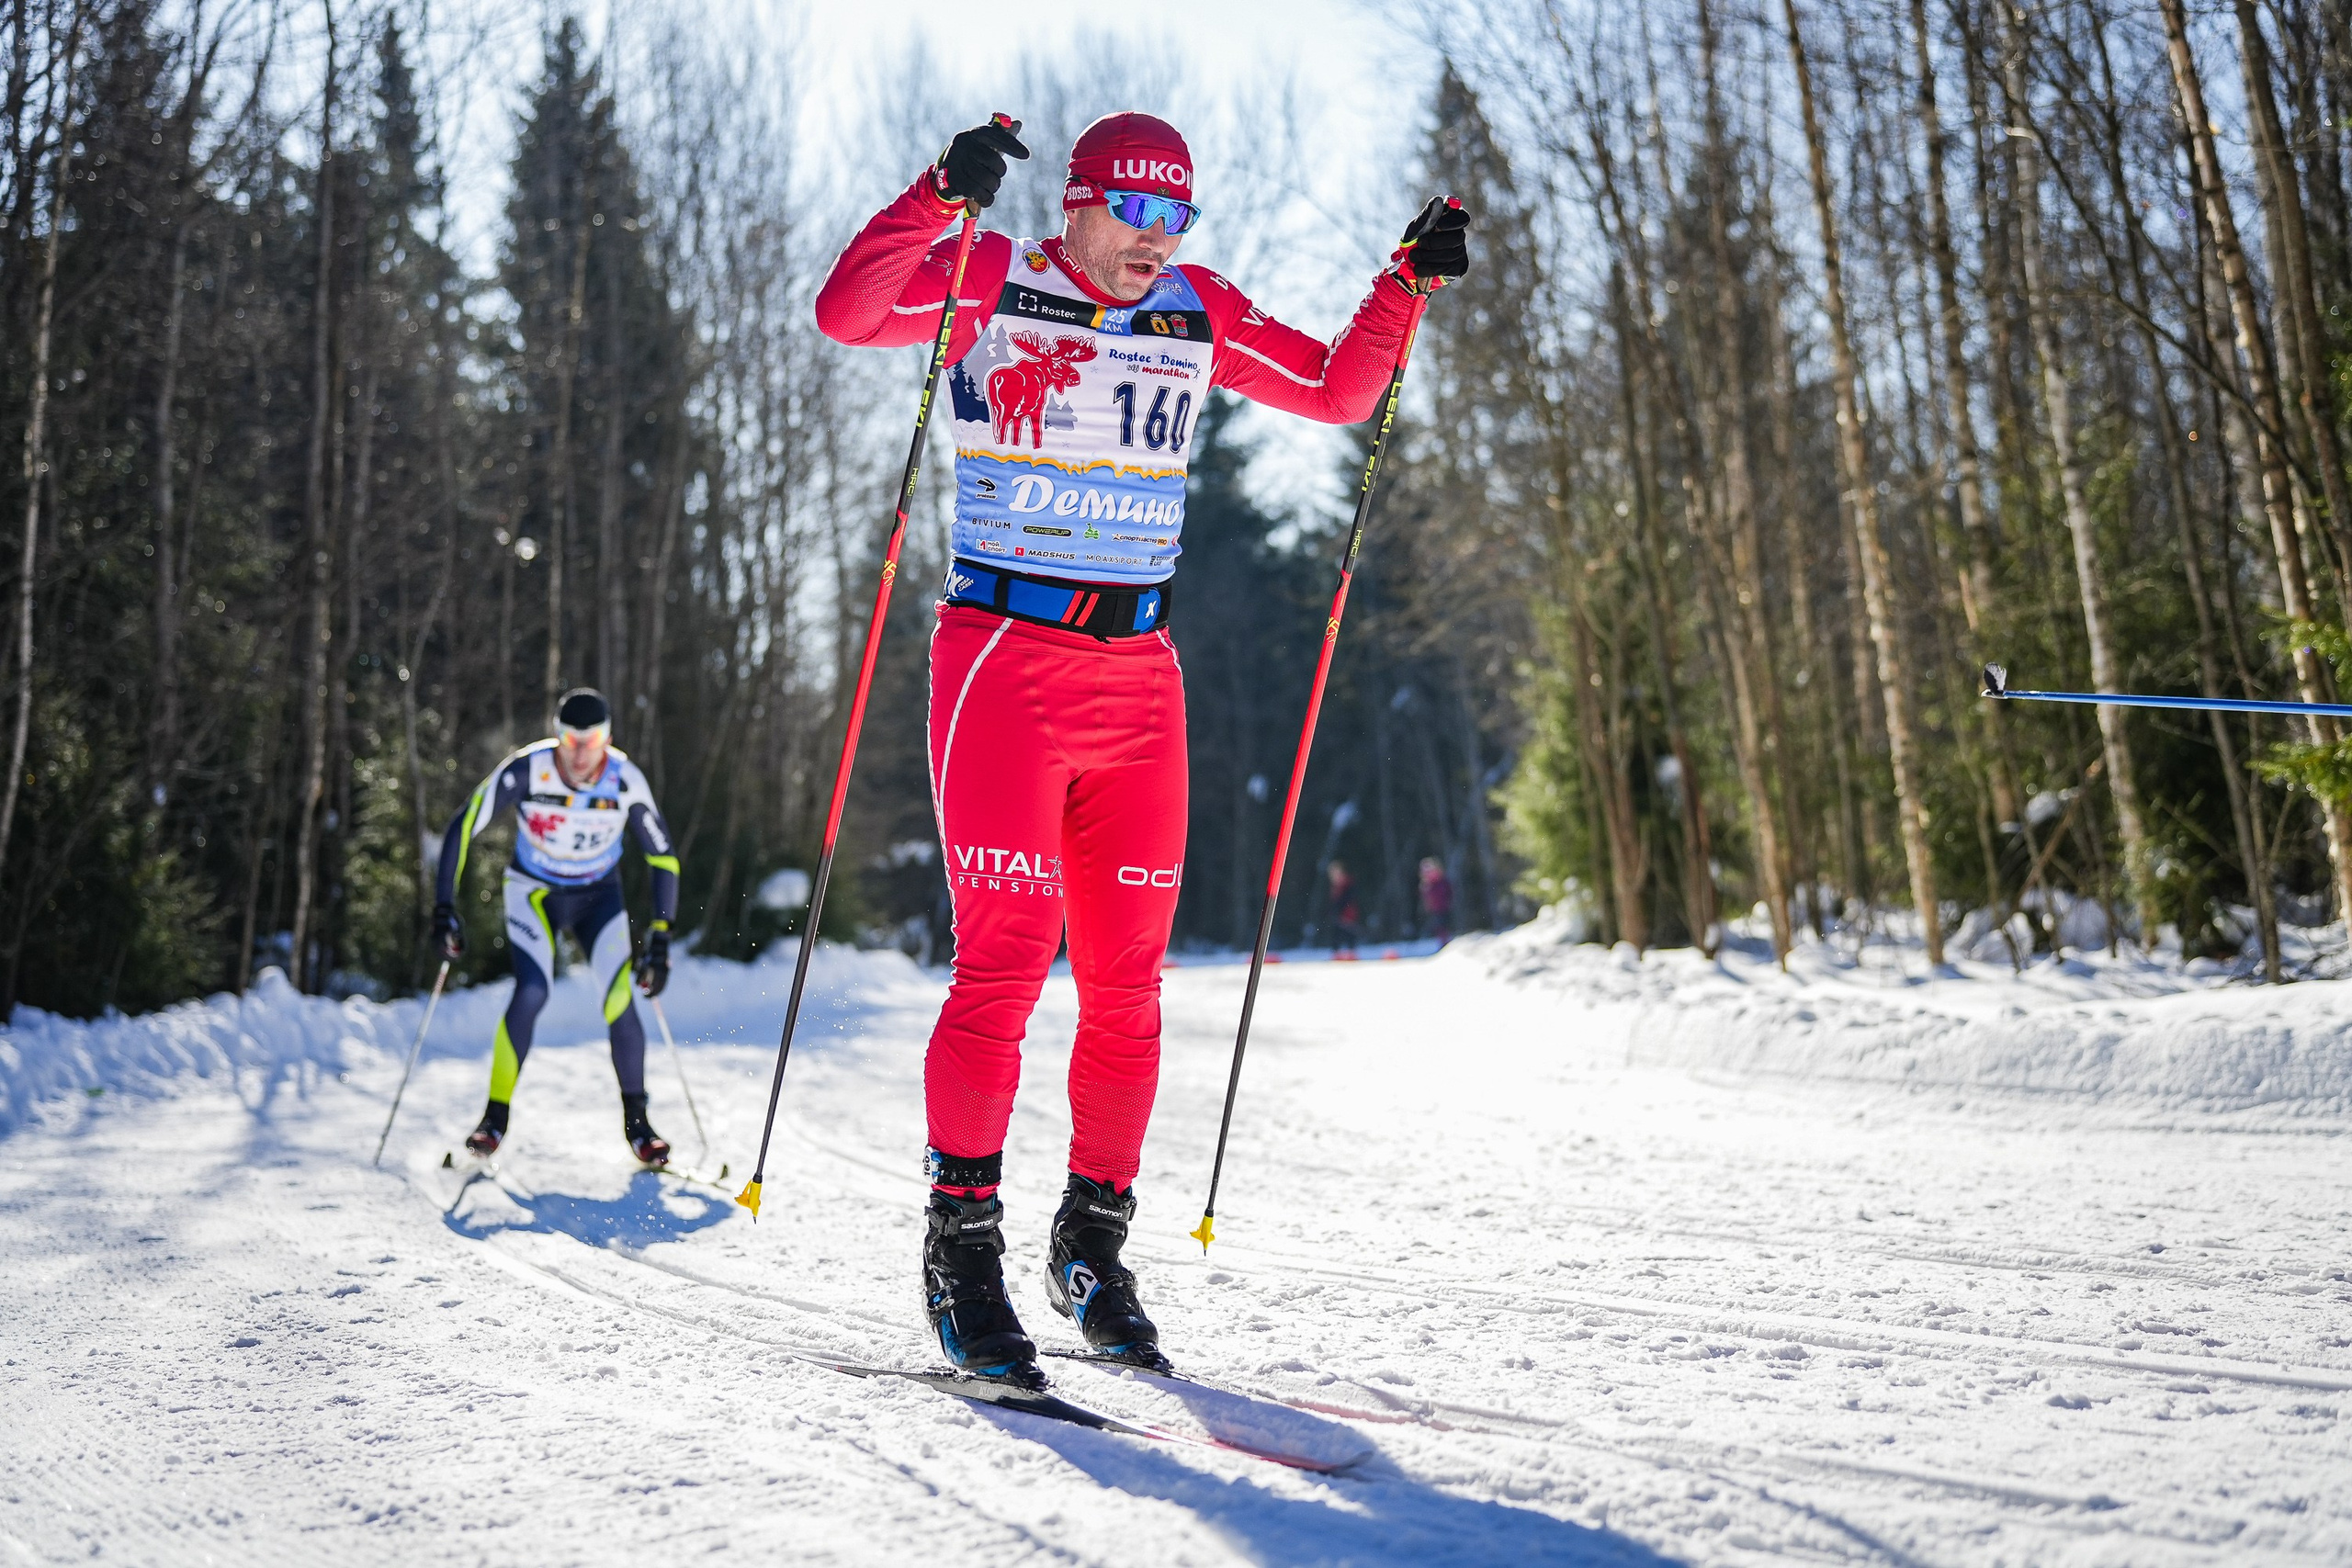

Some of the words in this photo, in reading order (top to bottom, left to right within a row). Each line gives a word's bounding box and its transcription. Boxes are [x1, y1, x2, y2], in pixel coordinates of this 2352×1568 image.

[1041, 305, 1076, 320] Rostec
[1107, 307, 1127, 324] 25
[1104, 321, 1124, 333] KM
[934, 311, 955, 366] LEKI
[1109, 349, 1151, 363] Rostec
[1160, 355, 1198, 369] Demino
[1142, 367, 1190, 379] marathon
[1381, 382, 1402, 434] LEKI
[1114, 381, 1193, 454] 160
[1008, 474, 1181, 526] Демино
[972, 518, 1011, 529] BIVIUM
[1025, 526, 1069, 536] POWERUP
[1028, 549, 1076, 559] MADSHUS
[1086, 554, 1142, 566] MOAXSPORT
[954, 844, 1049, 879] VITAL
[1117, 863, 1182, 888] odl
